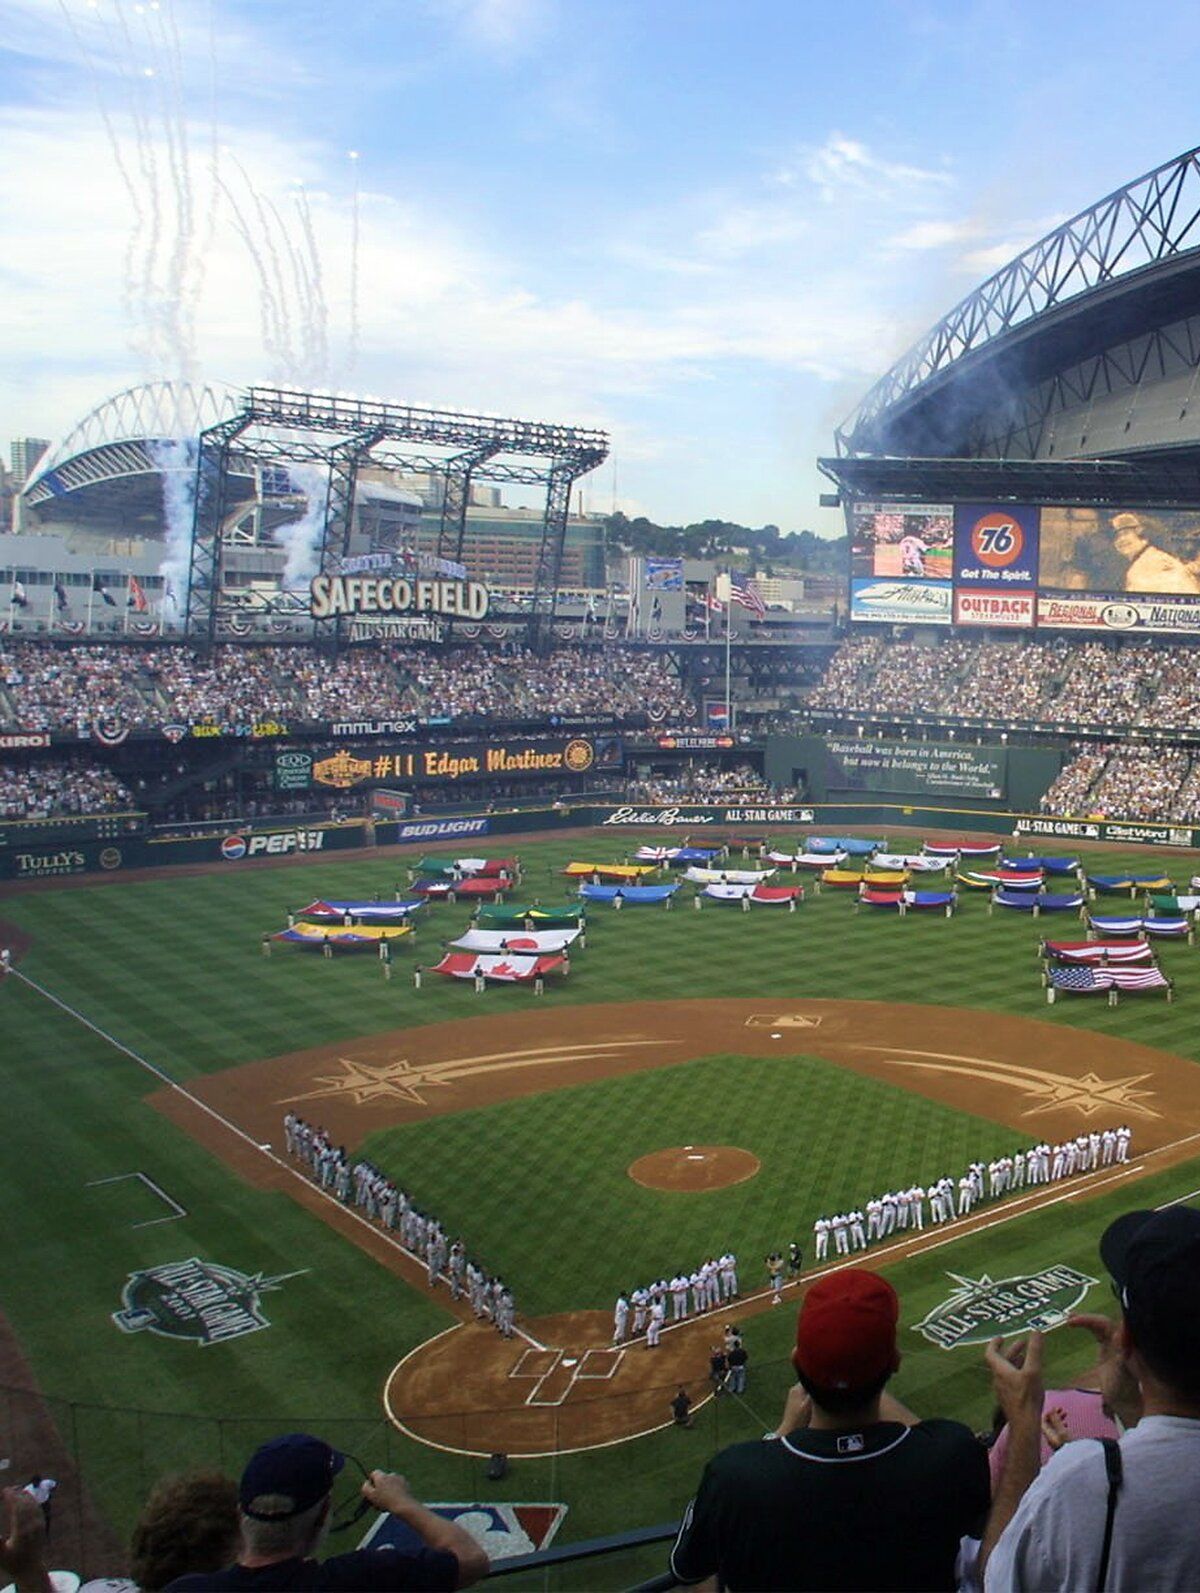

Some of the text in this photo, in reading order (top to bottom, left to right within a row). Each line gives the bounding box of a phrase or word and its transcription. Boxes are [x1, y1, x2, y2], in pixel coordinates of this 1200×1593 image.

[978, 524, 1015, 554] 76
[961, 569, 980, 579] Get
[982, 569, 1000, 580] The
[311, 575, 490, 620] SAFECO FIELD
[961, 598, 1030, 614] OUTBACK
[408, 624, 443, 643] GAME
[894, 747, 918, 758] born
[919, 748, 929, 758] in
[374, 754, 414, 778] #11
[424, 751, 480, 779] Edgar
[487, 747, 563, 772] Martinez
[891, 758, 928, 773] belongs
[930, 761, 941, 771] to
[942, 760, 957, 771] the
[603, 807, 714, 826] Eddie Bauer
[768, 810, 793, 821] GAME
[401, 819, 486, 838] BUD LIGHT
[1055, 822, 1079, 836] GAME
[248, 831, 324, 855] PEPSI
[1017, 1267, 1087, 1298] GAME
[994, 1296, 1050, 1324] 2001
